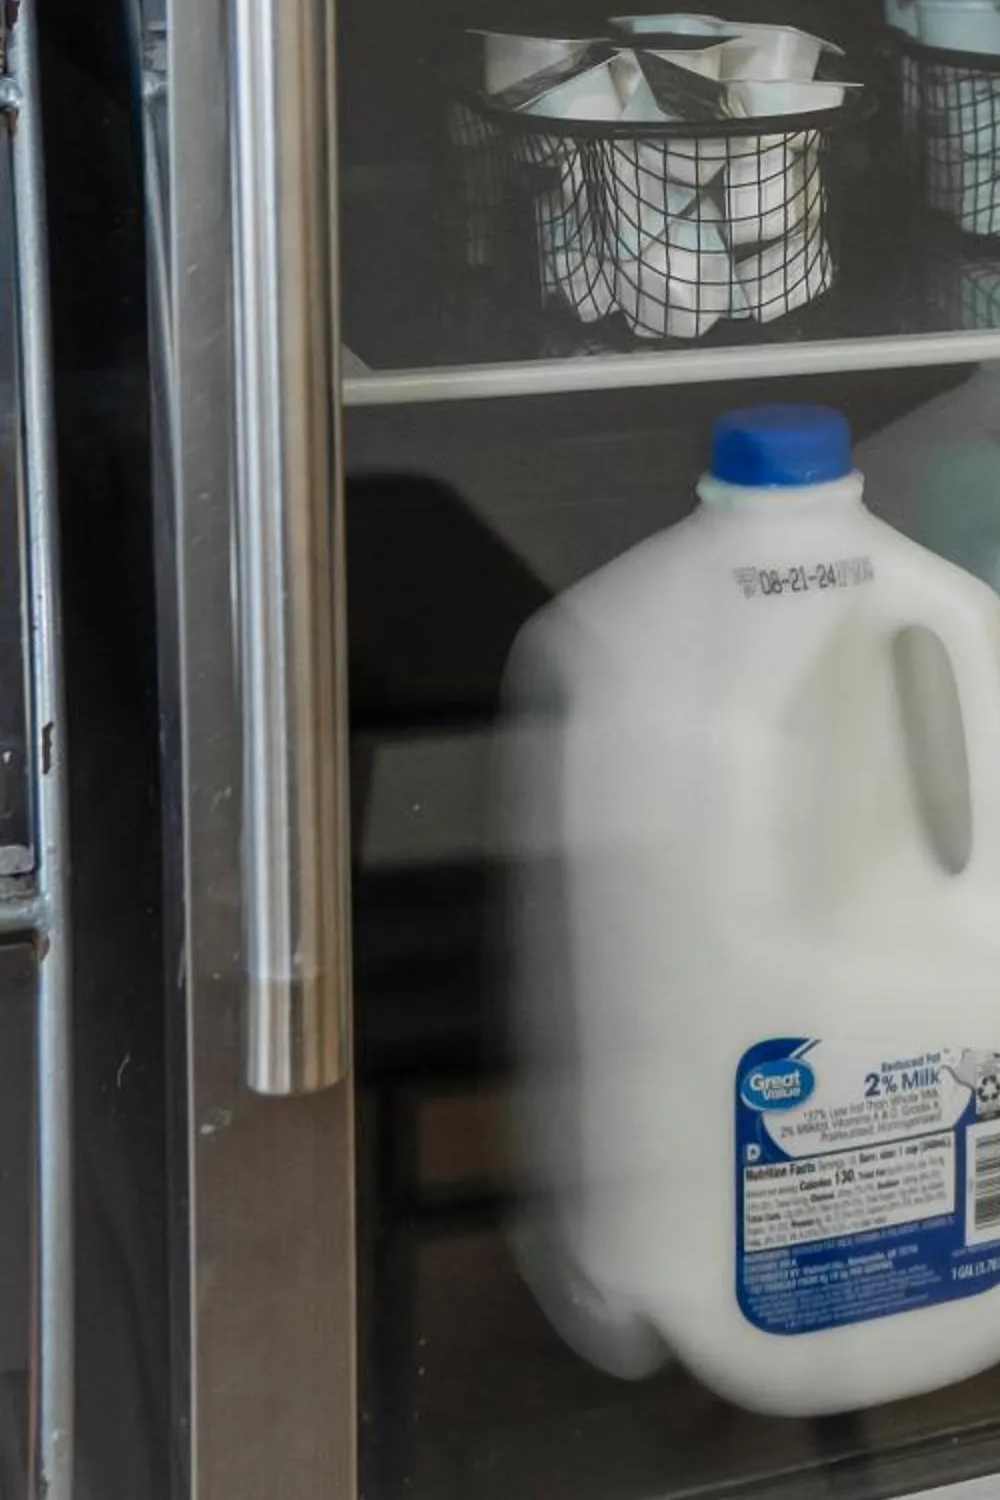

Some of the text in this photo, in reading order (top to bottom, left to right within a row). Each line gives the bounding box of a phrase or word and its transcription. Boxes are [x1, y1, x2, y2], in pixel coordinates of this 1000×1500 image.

[881, 1052, 941, 1073] Reduced Fat
[864, 1067, 941, 1097] 2% Milk
